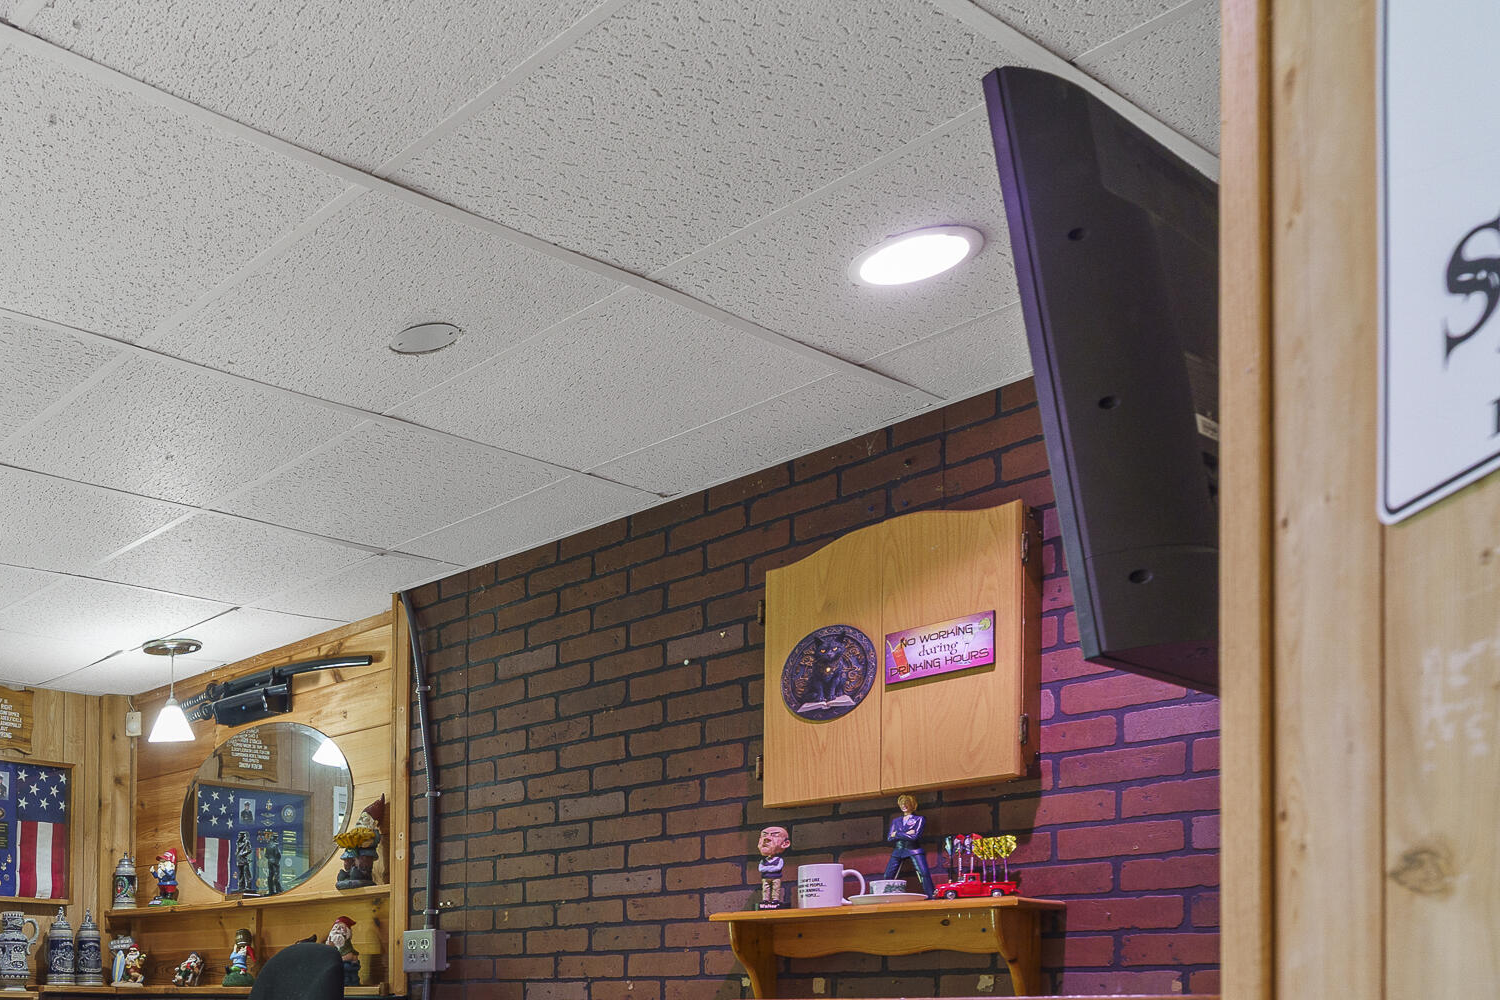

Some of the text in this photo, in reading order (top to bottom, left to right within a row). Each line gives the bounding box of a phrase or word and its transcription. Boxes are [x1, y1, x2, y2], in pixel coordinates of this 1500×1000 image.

[900, 623, 974, 649] NO WORKING
[918, 641, 959, 657] during
[889, 647, 990, 678] DRINKING HOURS
